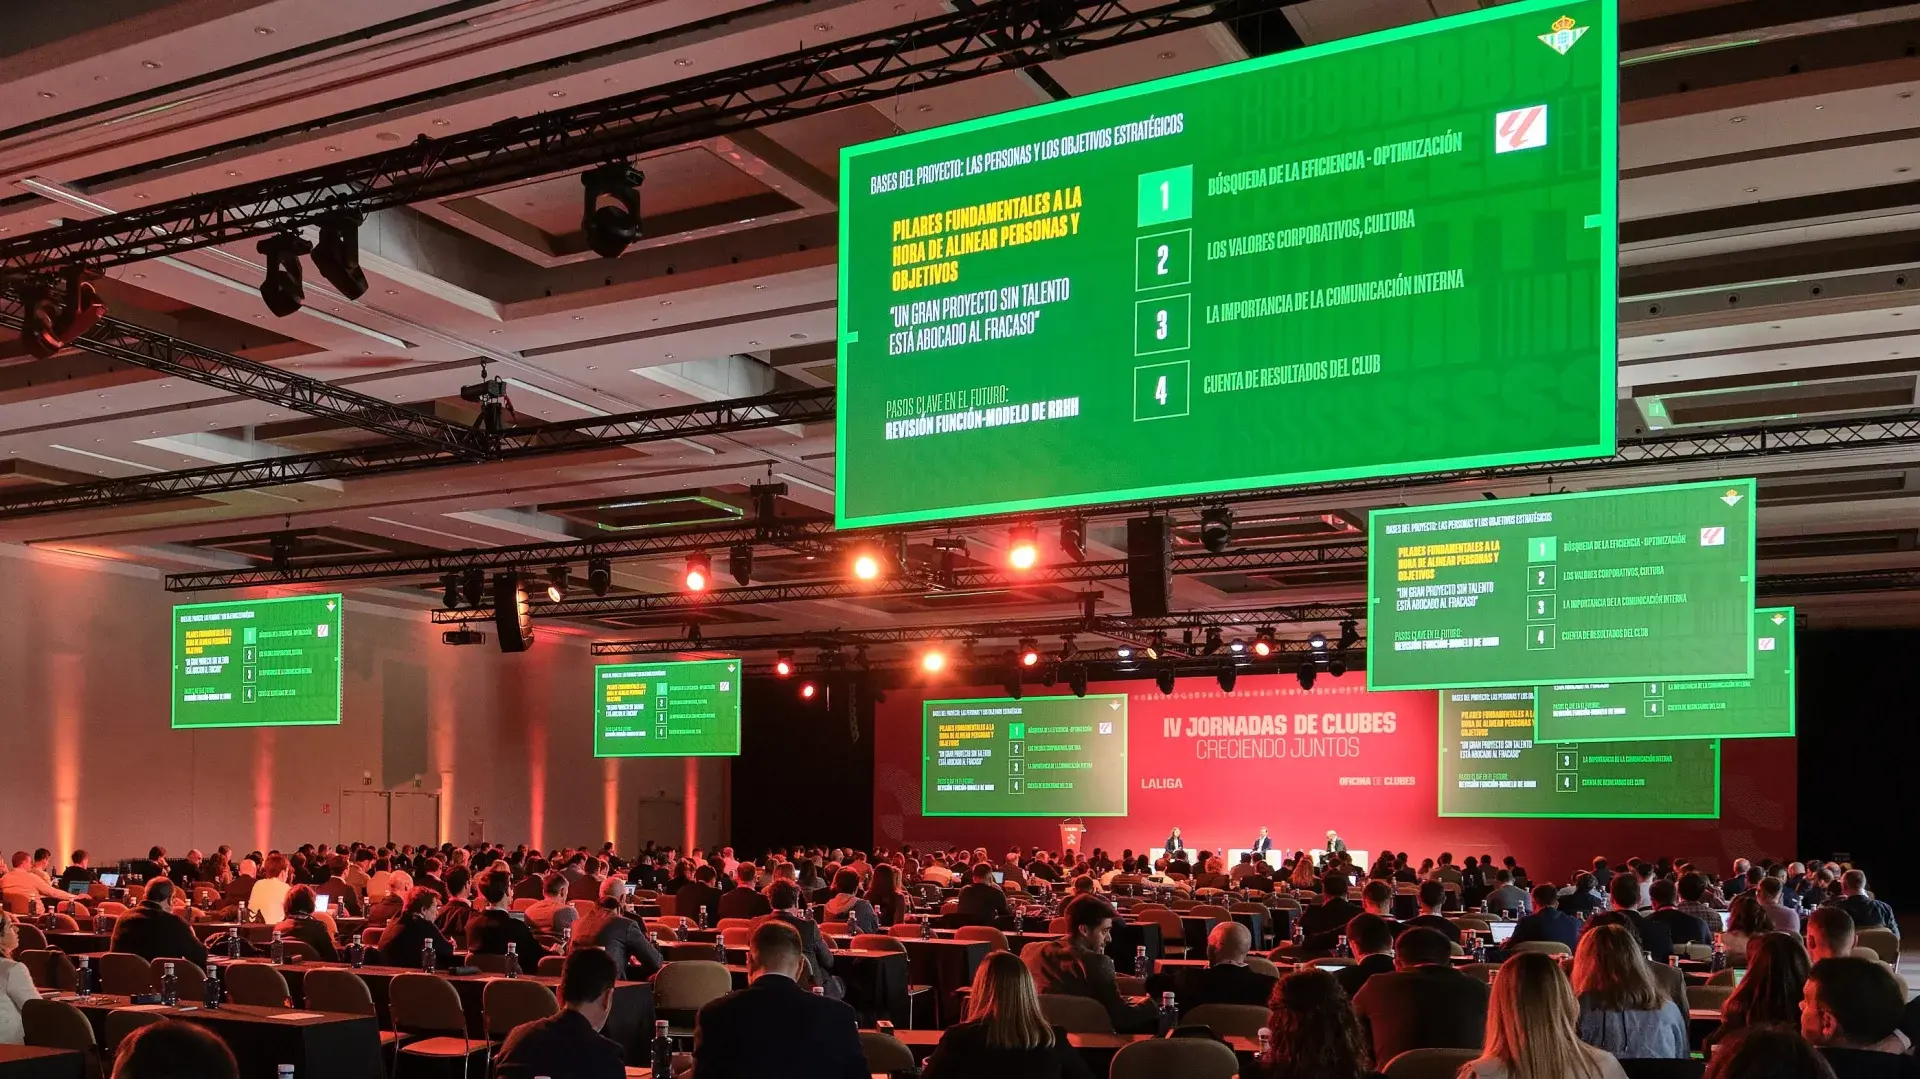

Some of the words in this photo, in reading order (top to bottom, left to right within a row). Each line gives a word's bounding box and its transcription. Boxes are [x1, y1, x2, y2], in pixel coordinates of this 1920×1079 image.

[870, 172, 897, 195] BASES
[900, 168, 915, 189] DEL
[916, 158, 963, 185] PROYECTO:
[966, 154, 982, 175] LAS
[984, 144, 1031, 172] PERSONAS
[1034, 142, 1040, 162] Y
[1041, 138, 1059, 160] LOS
[1061, 127, 1111, 156] OBJETIVOS
[1114, 113, 1183, 146] ESTRATÉGICOS
[1208, 167, 1267, 196] BÚSQUEDA
[1269, 164, 1283, 185] DE
[1285, 161, 1300, 182] LA
[1301, 149, 1364, 179] EFICIENCIA
[1373, 129, 1462, 166] OPTIMIZACIÓN
[1160, 180, 1168, 211] 1
[893, 212, 942, 241] PILARES
[945, 192, 1050, 231] FUNDAMENTALES
[1053, 189, 1062, 212] A
[1065, 185, 1082, 209] LA
[892, 240, 925, 266] HORA
[928, 237, 942, 260] DE
[945, 227, 998, 257] ALINEAR
[1000, 214, 1068, 247] PERSONAS
[1070, 212, 1079, 235] Y
[1207, 239, 1226, 260] LOS
[1229, 231, 1275, 257] VALORES
[1157, 243, 1168, 275] 2
[892, 260, 958, 291] OBJETIVOS
[911, 298, 939, 325] GRAN
[942, 289, 997, 320] PROYECTO
[1000, 285, 1019, 311] SIN
[1021, 277, 1069, 308] TALENTO
[1206, 304, 1219, 324] LA
[1221, 293, 1292, 321] IMPORTANCIA
[1295, 291, 1308, 311] DE
[1310, 289, 1324, 309] LA
[1326, 273, 1412, 306] COMUNICACIÓN
[1413, 268, 1464, 294] INTERNA
[889, 326, 914, 355] ESTÁ
[916, 322, 965, 351] ABOCADO
[969, 319, 981, 343] AL
[1156, 309, 1167, 340] 3
[1203, 370, 1244, 393] CUENTA
[1245, 369, 1258, 388] DE
[1260, 360, 1327, 387] RESULTADOS
[1329, 357, 1350, 378] DEL
[1351, 353, 1380, 375] CLUB
[886, 397, 913, 418] PASOS
[916, 393, 942, 414] CLAVE
[944, 391, 956, 411] EN
[958, 390, 968, 409] EL
[970, 384, 1008, 408] FUTURO:
[1155, 375, 1167, 406] 4
[885, 413, 933, 439] REVISIÓN
[935, 403, 1029, 433] FUNCIÓN-MODELO
[1031, 401, 1045, 422] DE
[1048, 397, 1078, 420] RRHH
[1540, 542, 1544, 556] 1
[1538, 570, 1544, 584] 2
[1538, 600, 1544, 614] 3
[1537, 630, 1543, 643] 4
[1015, 726, 1018, 735] 1
[1163, 717, 1182, 737] IV
[1186, 715, 1287, 737] JORNADAS
[1294, 713, 1319, 734] DE
[1322, 712, 1397, 734] CLUBES
[1014, 744, 1018, 753] 2
[1196, 738, 1286, 759] CRECIENDO
[1290, 737, 1360, 758] JUNTOS
[1564, 755, 1569, 765] 3
[1014, 763, 1018, 771] 3
[1339, 776, 1371, 786] OFICINA
[1384, 776, 1416, 786] CLUBES
[1564, 777, 1569, 787] 4
[1014, 781, 1018, 790] 4
[1141, 778, 1183, 789] LALIGA
